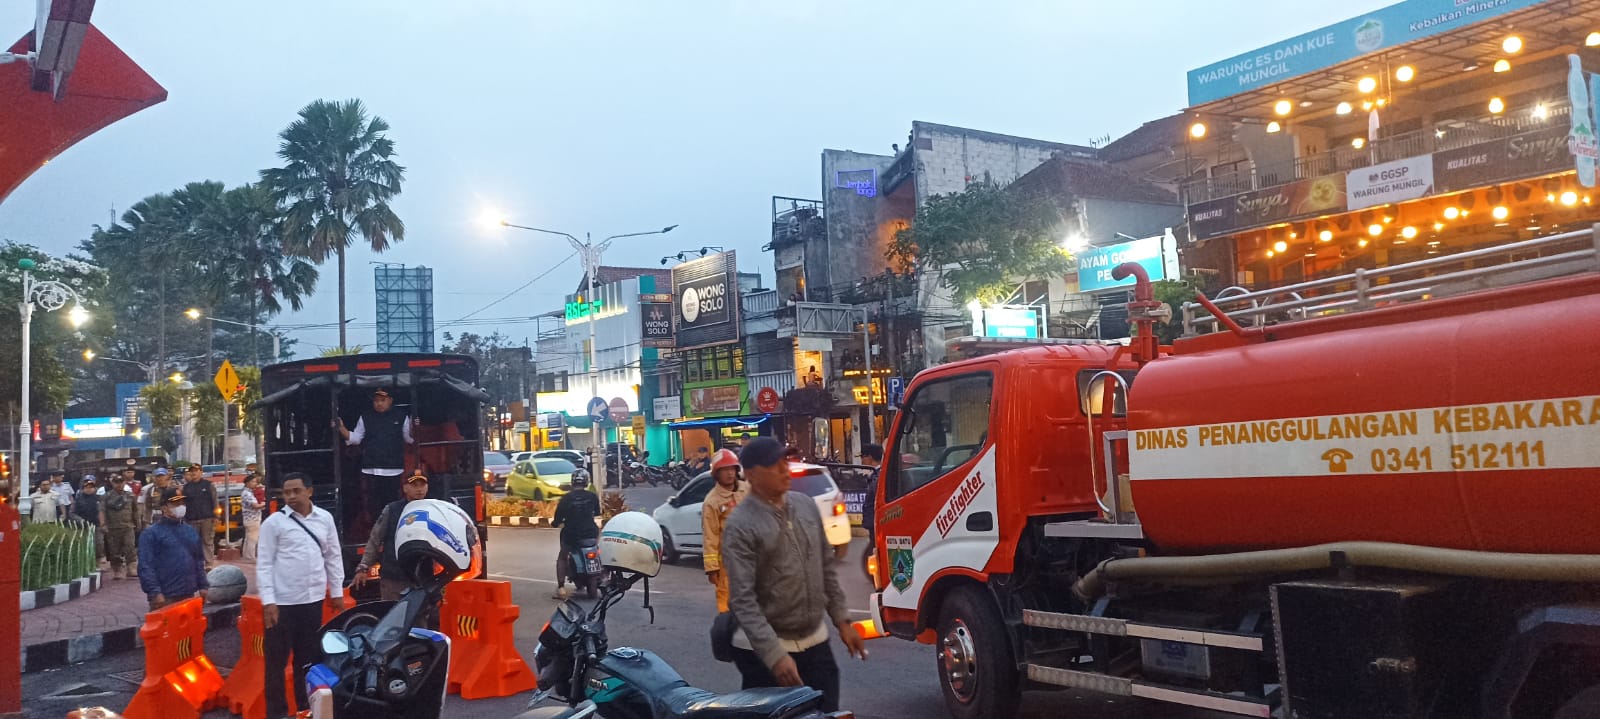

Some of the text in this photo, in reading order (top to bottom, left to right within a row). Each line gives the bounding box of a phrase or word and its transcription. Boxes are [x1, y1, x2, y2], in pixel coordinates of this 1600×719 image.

[1409, 11, 1463, 32] Kebaikan
[1198, 58, 1253, 85] WARUNG
[1255, 55, 1271, 68] ES
[1274, 42, 1304, 61] DAN
[1306, 32, 1336, 51] KUE
[1238, 62, 1290, 87] MUNGIL
[1446, 154, 1488, 170] KUALITAS
[1380, 166, 1409, 182] GGSP
[1352, 185, 1391, 200] WARUNG
[1392, 178, 1426, 192] MUNGIL
[1235, 191, 1290, 217] Surya
[1079, 253, 1109, 270] AYAM
[697, 283, 725, 300] WONG
[565, 302, 581, 320] BSI
[700, 296, 724, 313] SOLO
[645, 320, 669, 329] WONG
[647, 327, 668, 335] SOLO
[891, 378, 900, 393] P
[1135, 428, 1189, 451] DINAS
[1199, 411, 1419, 447] PENANGGULANGAN
[1370, 439, 1547, 472] 0341 512111
[935, 470, 985, 539] firefighter
